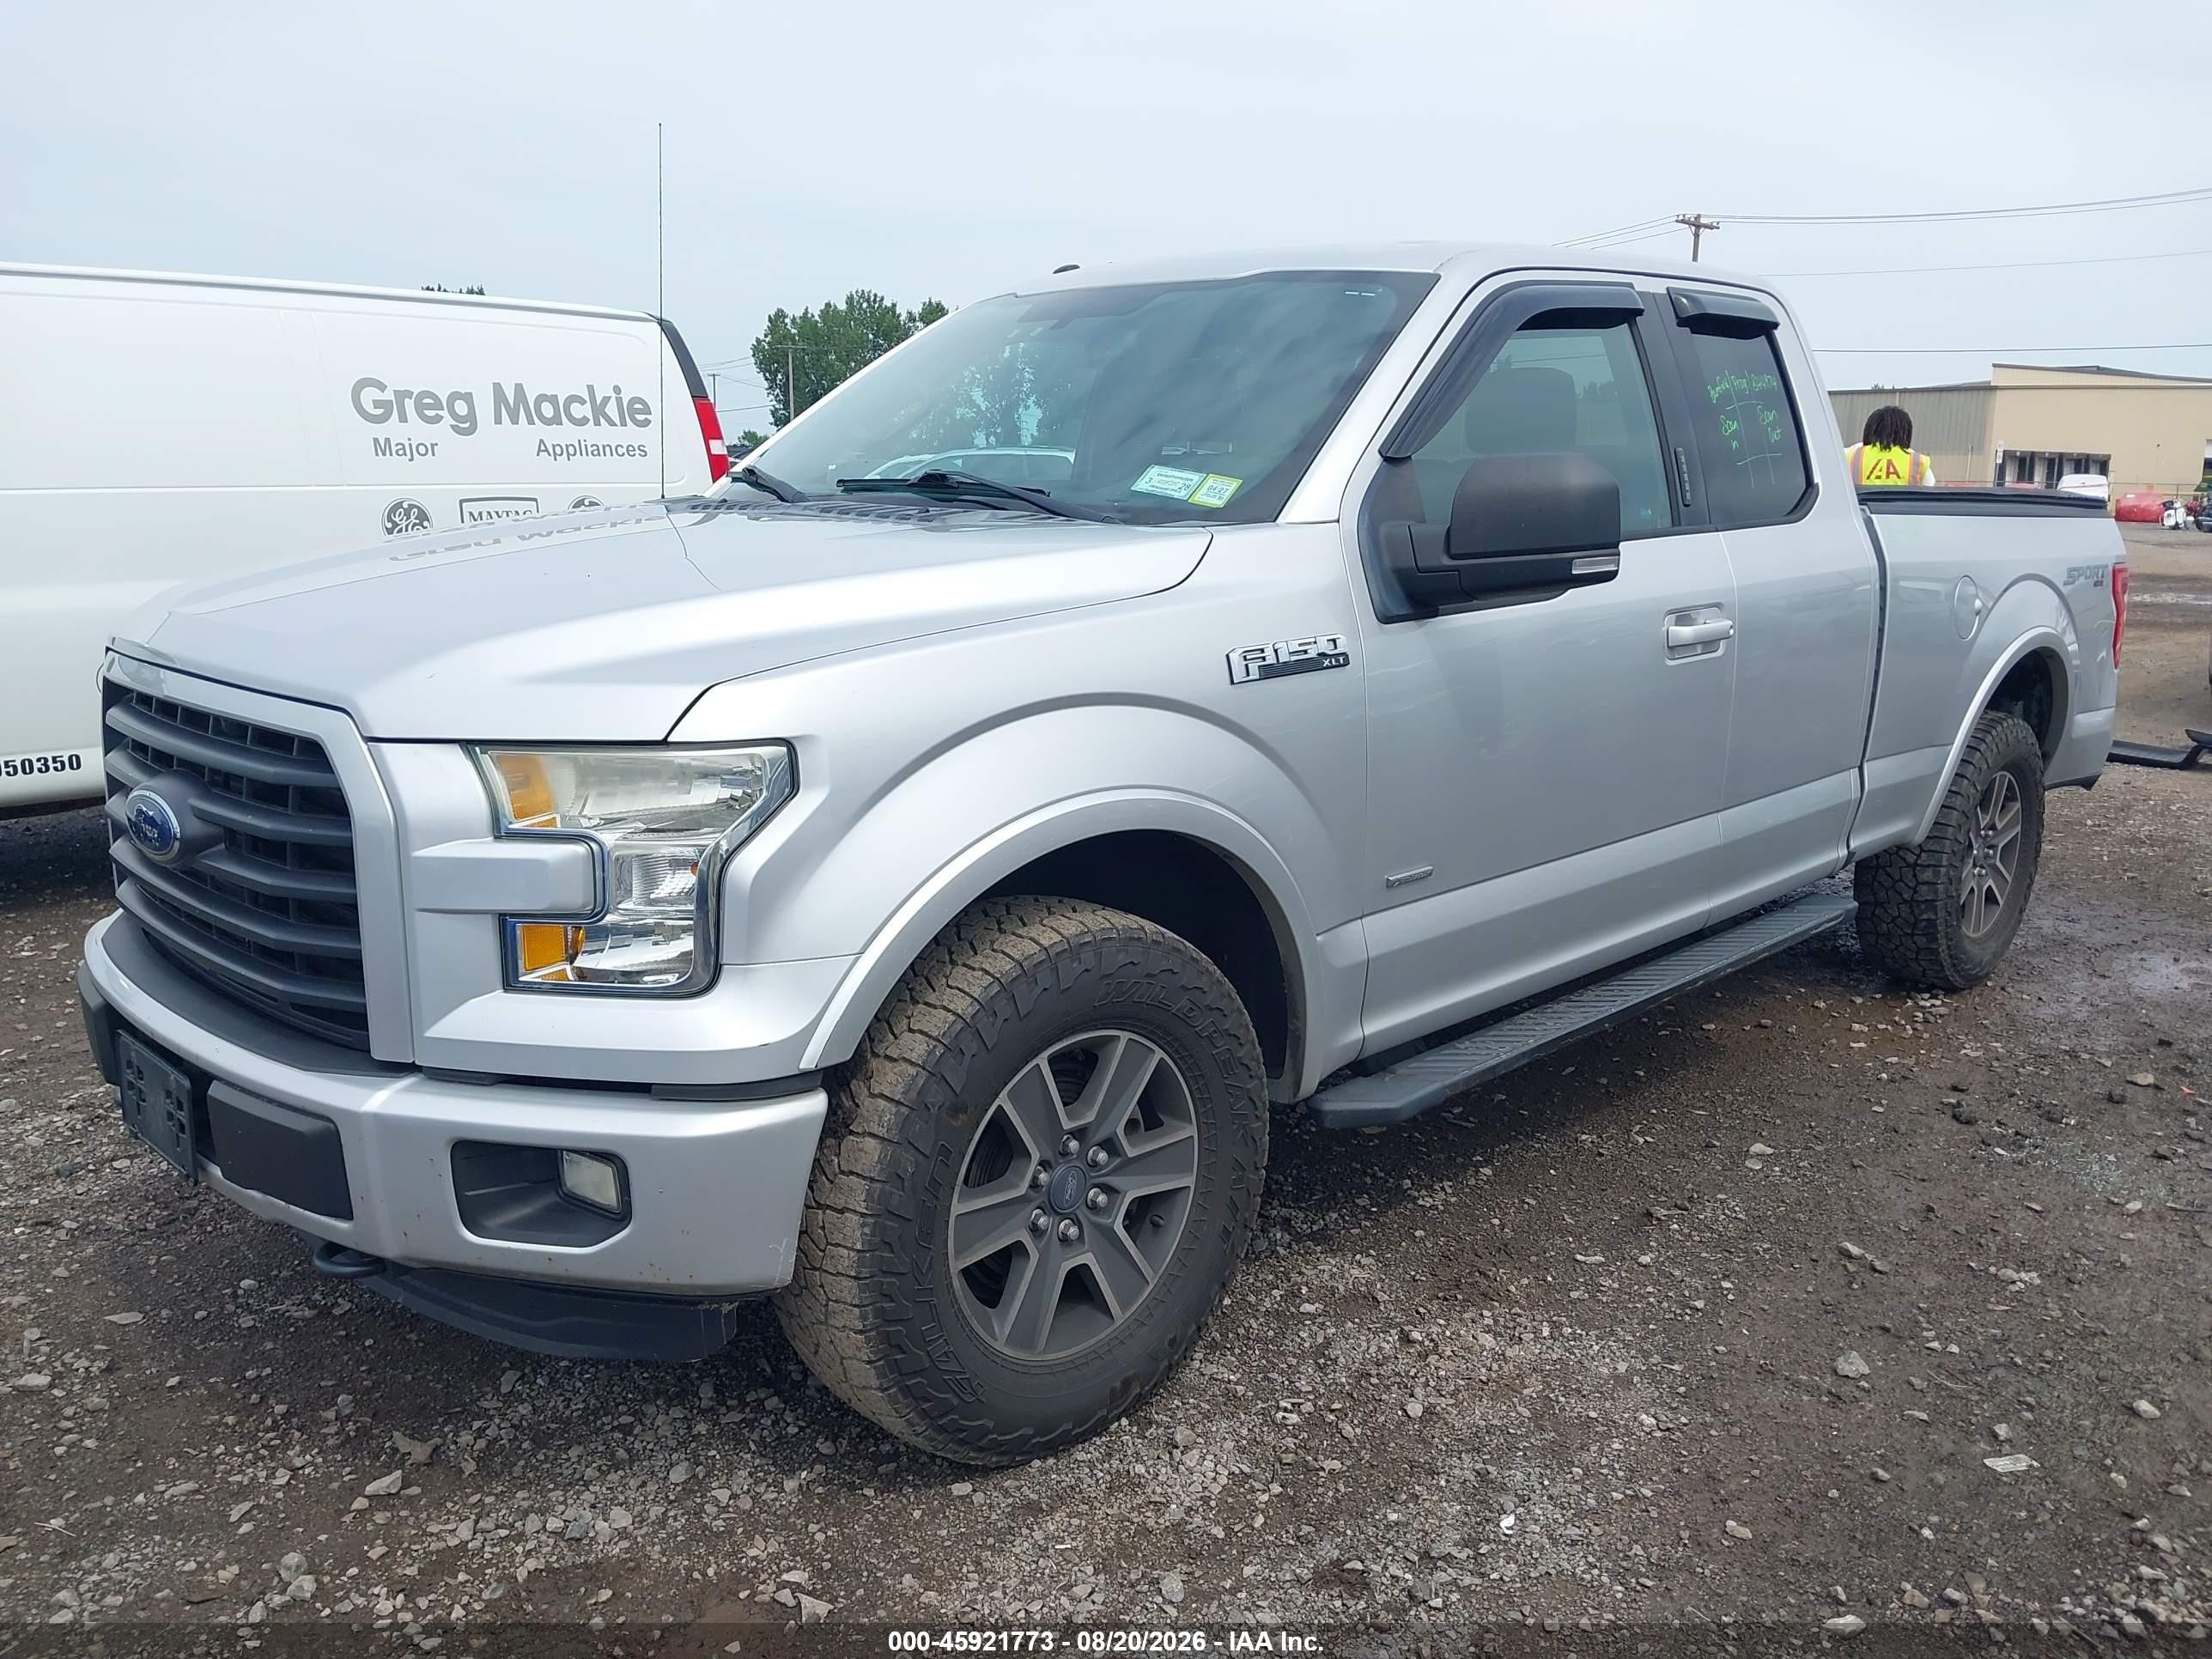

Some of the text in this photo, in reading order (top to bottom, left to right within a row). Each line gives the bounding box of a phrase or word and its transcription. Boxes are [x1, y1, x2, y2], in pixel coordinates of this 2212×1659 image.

[351, 377, 653, 436] Greg Mackie
[372, 436, 648, 462] Major Appliances
[1177, 483, 1192, 491] 28
[1322, 656, 1346, 667] XLT
[0, 753, 82, 777] 50350
[1093, 978, 1250, 1149] WILDPEAK
